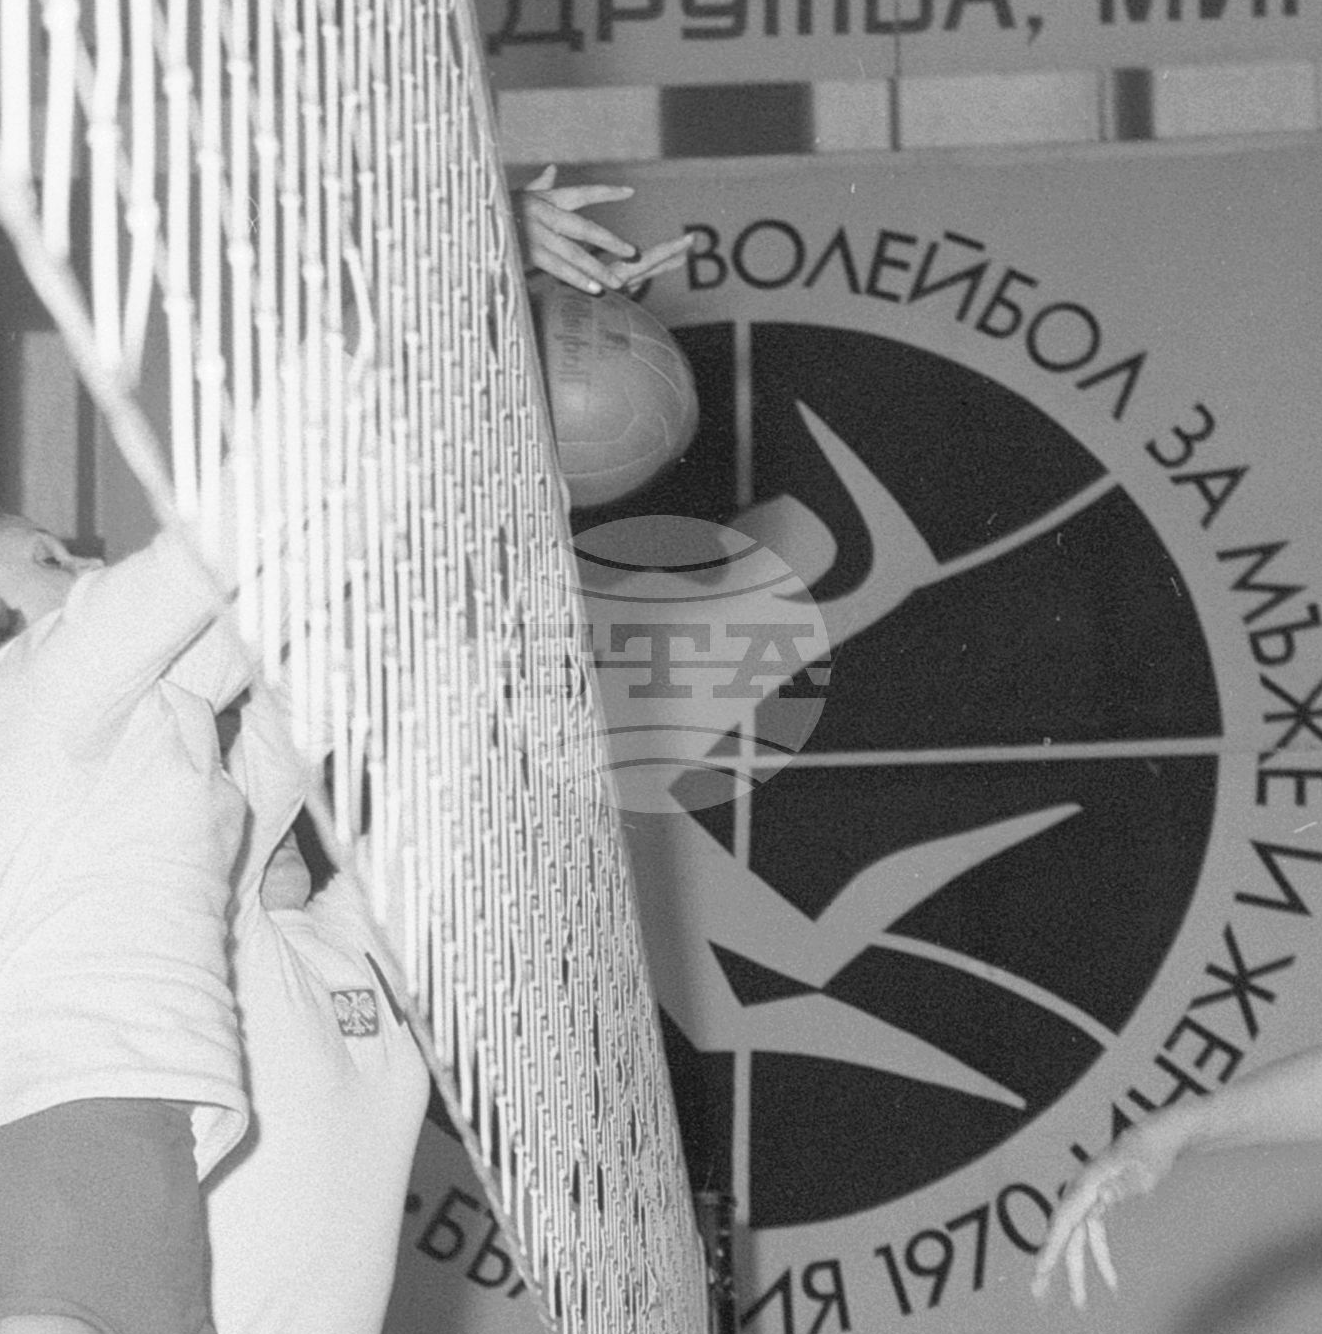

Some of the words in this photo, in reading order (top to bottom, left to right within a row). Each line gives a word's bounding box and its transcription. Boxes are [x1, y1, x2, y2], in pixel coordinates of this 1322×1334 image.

[684, 220, 1145, 420] ВОЛЕЙБОЛ
[1145, 403, 1250, 527] ЗА
[875, 1181, 1053, 1316] 1970
